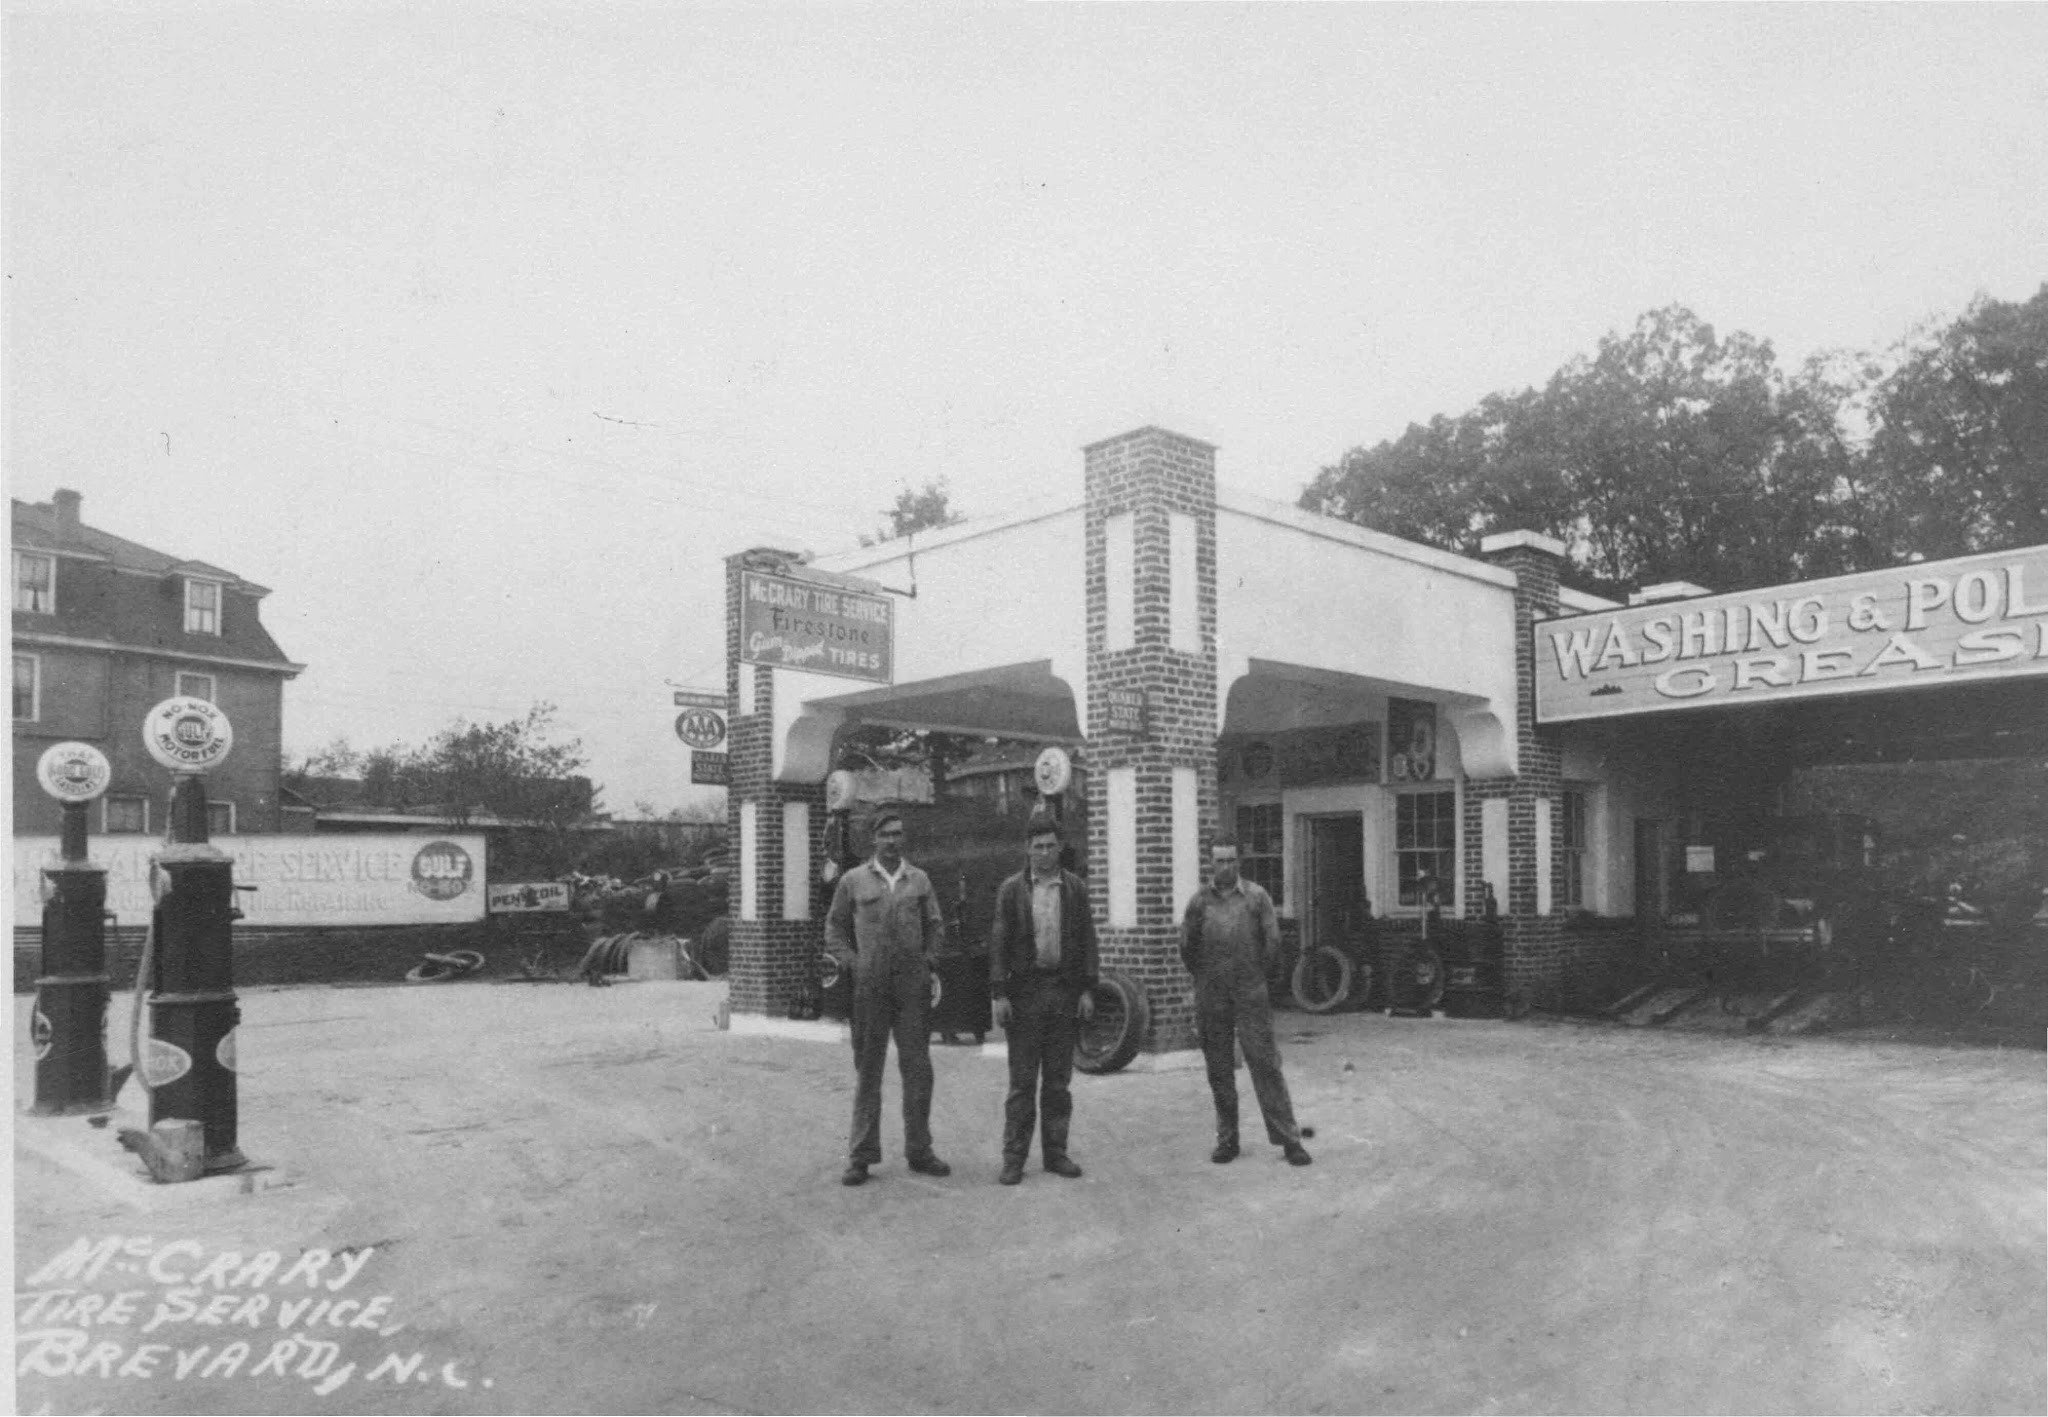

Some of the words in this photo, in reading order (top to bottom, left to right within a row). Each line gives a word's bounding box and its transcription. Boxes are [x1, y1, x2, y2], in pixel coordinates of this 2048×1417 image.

[813, 591, 840, 616] TIRE
[842, 596, 888, 625] SERVICE
[769, 606, 870, 645] Firestone
[1550, 597, 1830, 682] WASHING
[1847, 591, 1893, 633] &
[1904, 564, 2048, 633] POL
[827, 647, 881, 670] TIRES
[683, 715, 718, 739] AAA
[159, 733, 199, 760] MOTOR
[201, 737, 224, 759] FUEL
[280, 850, 403, 883] SERVICE
[418, 853, 468, 879] GULF
[491, 885, 565, 908] PENOIL
